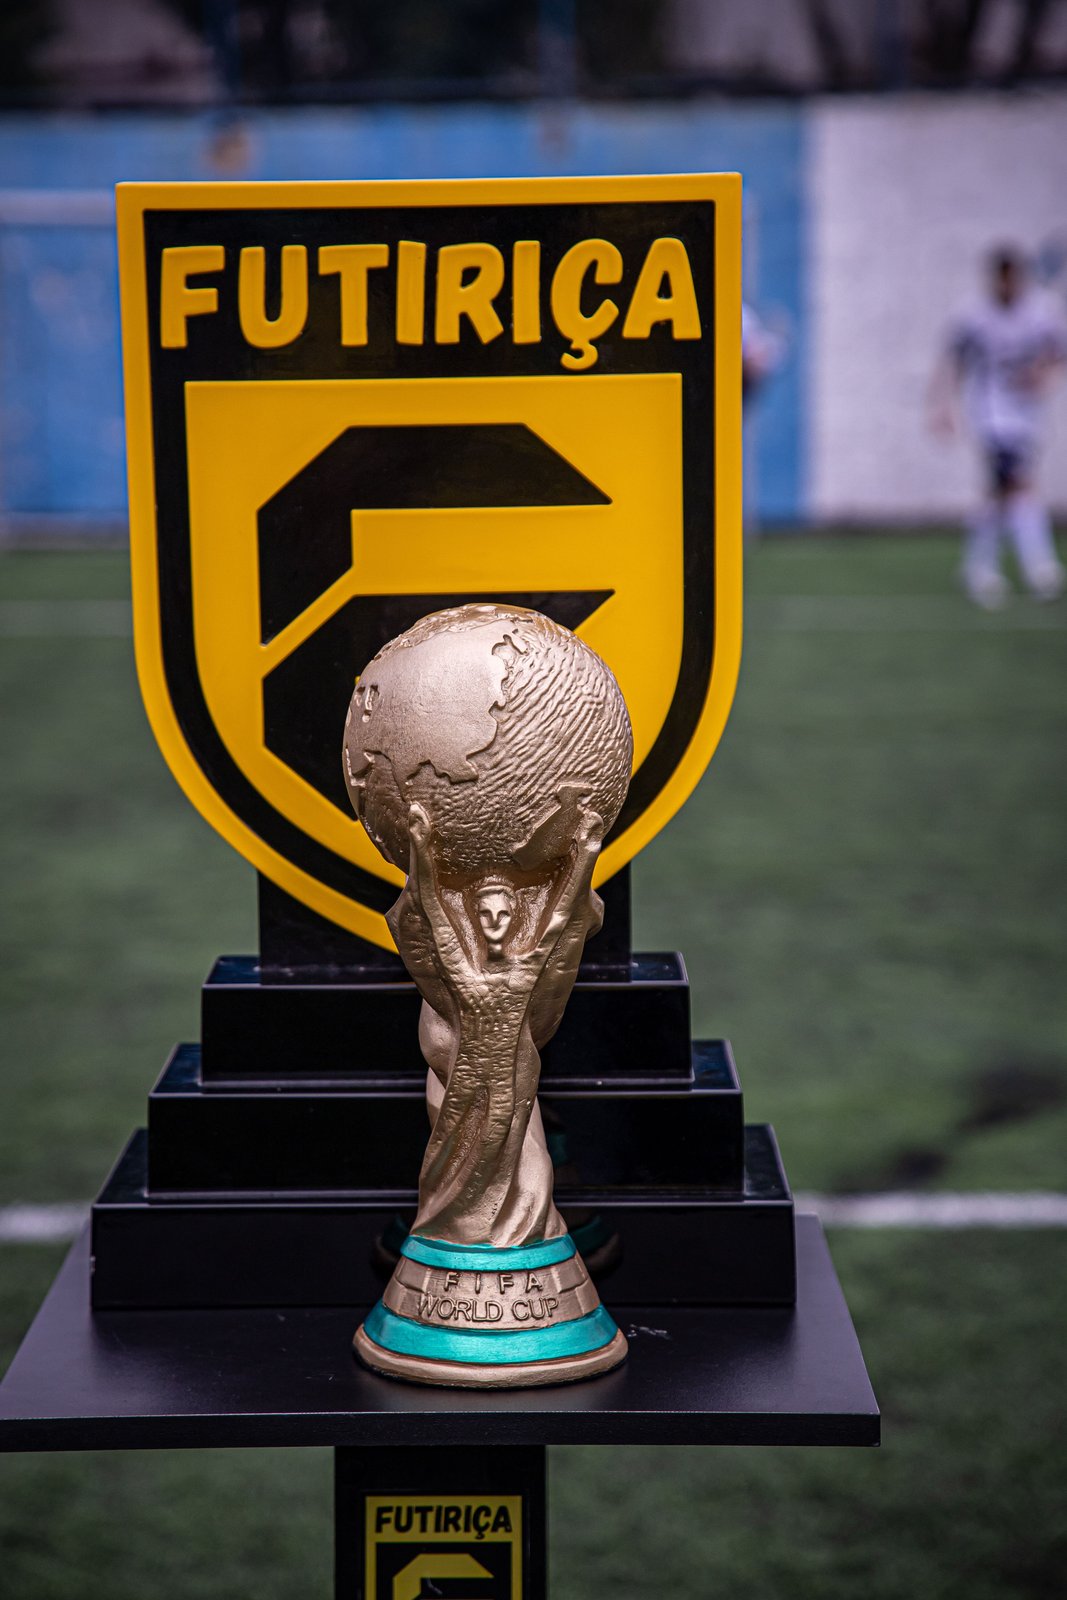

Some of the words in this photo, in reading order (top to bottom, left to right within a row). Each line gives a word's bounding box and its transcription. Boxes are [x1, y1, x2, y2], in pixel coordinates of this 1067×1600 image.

[161, 238, 702, 369] FUTIRIÇA
[445, 1272, 543, 1294] FIFA
[418, 1293, 503, 1322] WORLD
[511, 1297, 559, 1321] CUP
[375, 1505, 512, 1540] FUTIRIÇA
